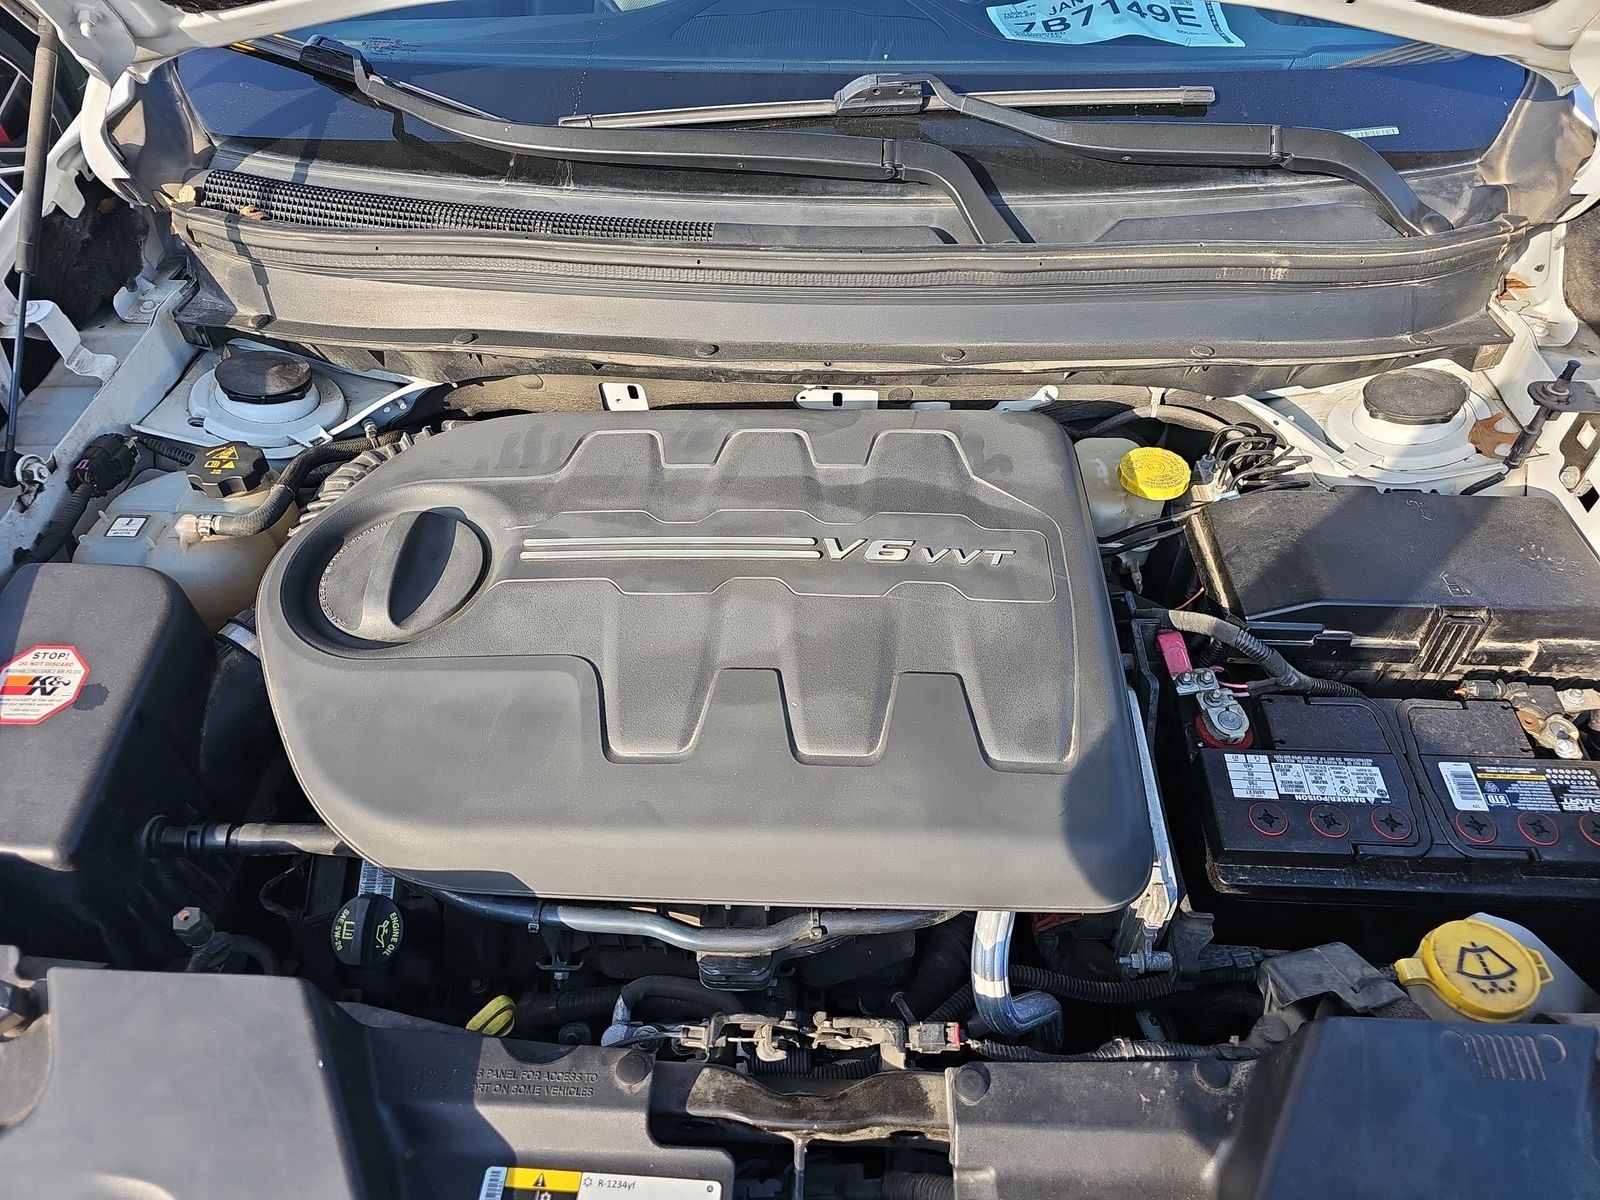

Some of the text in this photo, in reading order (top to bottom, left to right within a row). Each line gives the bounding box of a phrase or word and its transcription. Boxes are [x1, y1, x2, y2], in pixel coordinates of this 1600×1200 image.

[824, 538, 1016, 566] V6 VVT
[1295, 794, 1366, 803] DANGER/POISON
[334, 908, 350, 951] SAE 5W-20
[382, 912, 400, 956] ENGINE OIL
[487, 1069, 518, 1079] PANEL
[521, 1070, 540, 1080] FOR
[544, 1072, 582, 1082] ACCESS
[585, 1073, 598, 1083] TO
[493, 1084, 509, 1094] ON
[512, 1084, 542, 1095] SOME
[545, 1086, 594, 1097] VEHICLES
[598, 1179, 636, 1190] R-1234yf
